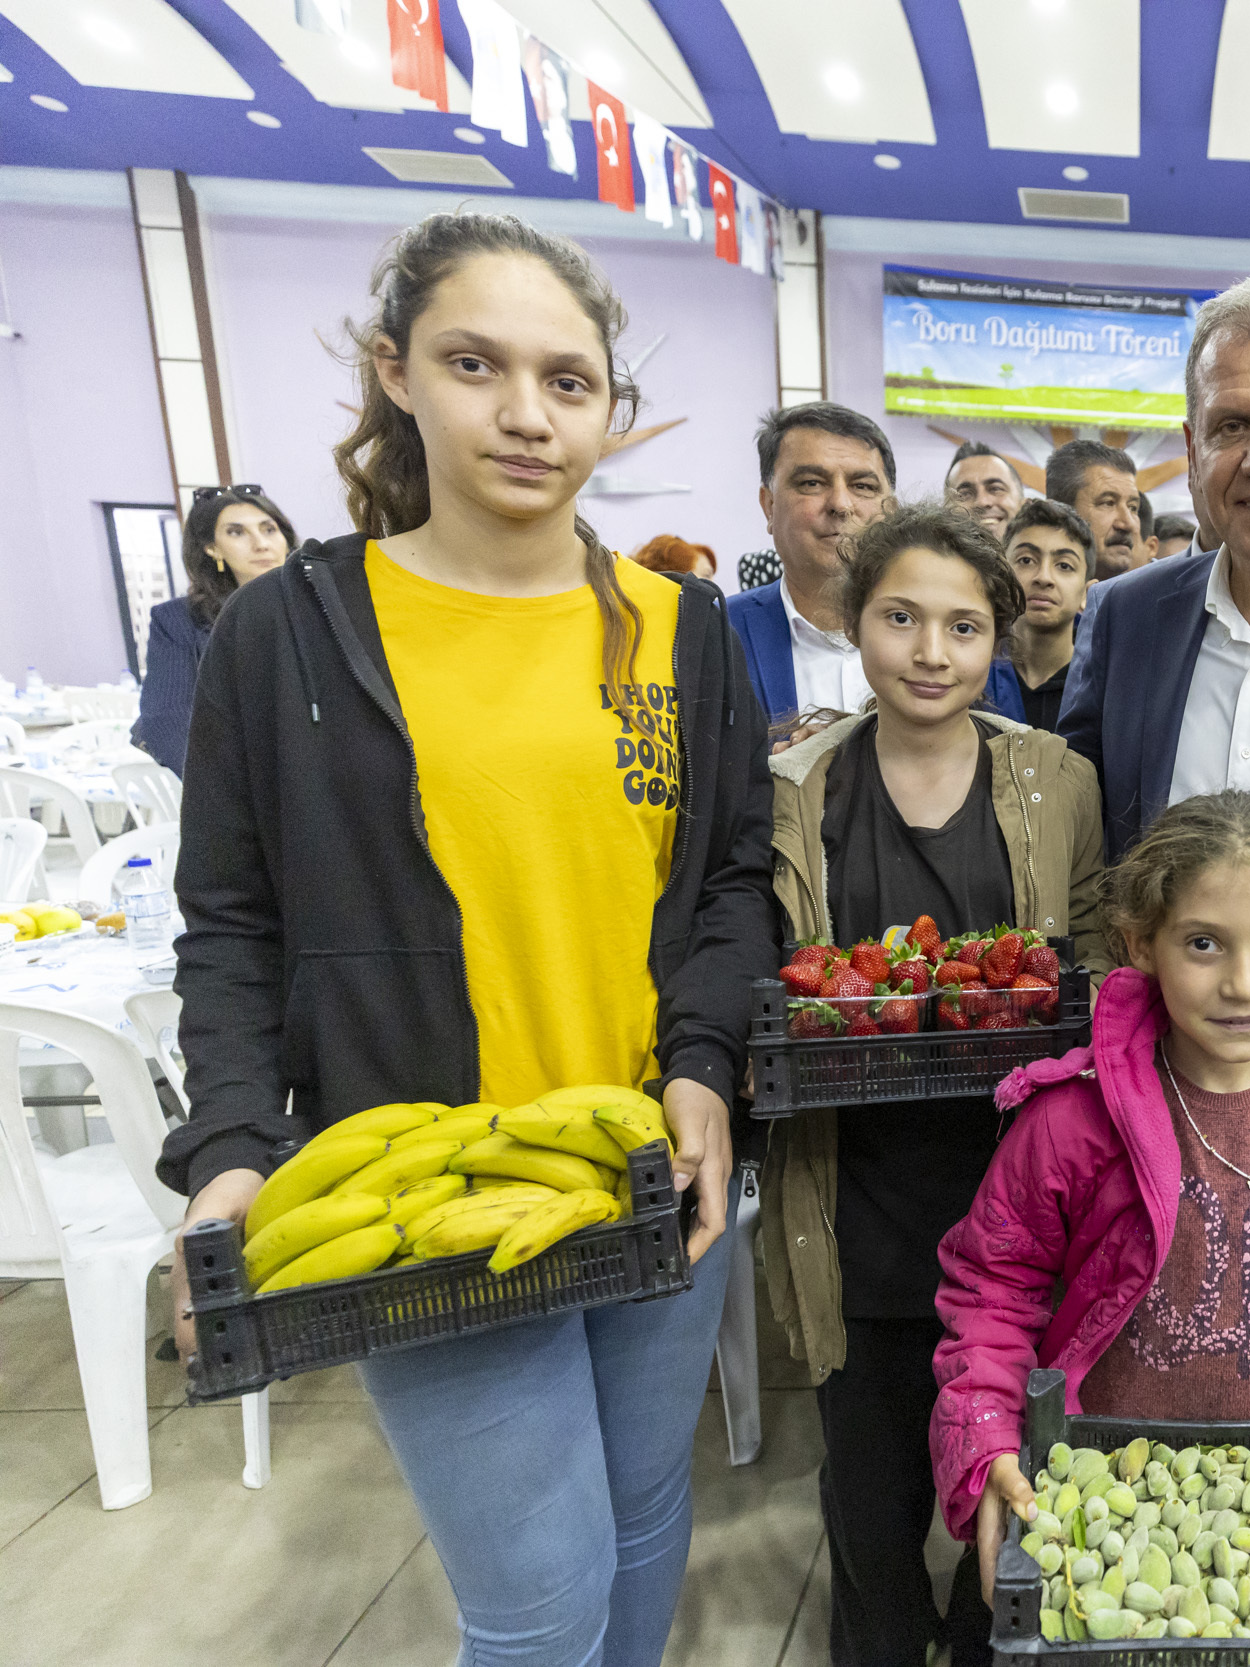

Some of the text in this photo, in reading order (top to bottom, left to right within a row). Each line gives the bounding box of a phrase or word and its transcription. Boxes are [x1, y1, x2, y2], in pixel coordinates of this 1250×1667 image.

[914, 311, 976, 344] Boru
[1102, 324, 1180, 358] Töreni
[600, 684, 613, 710] I
